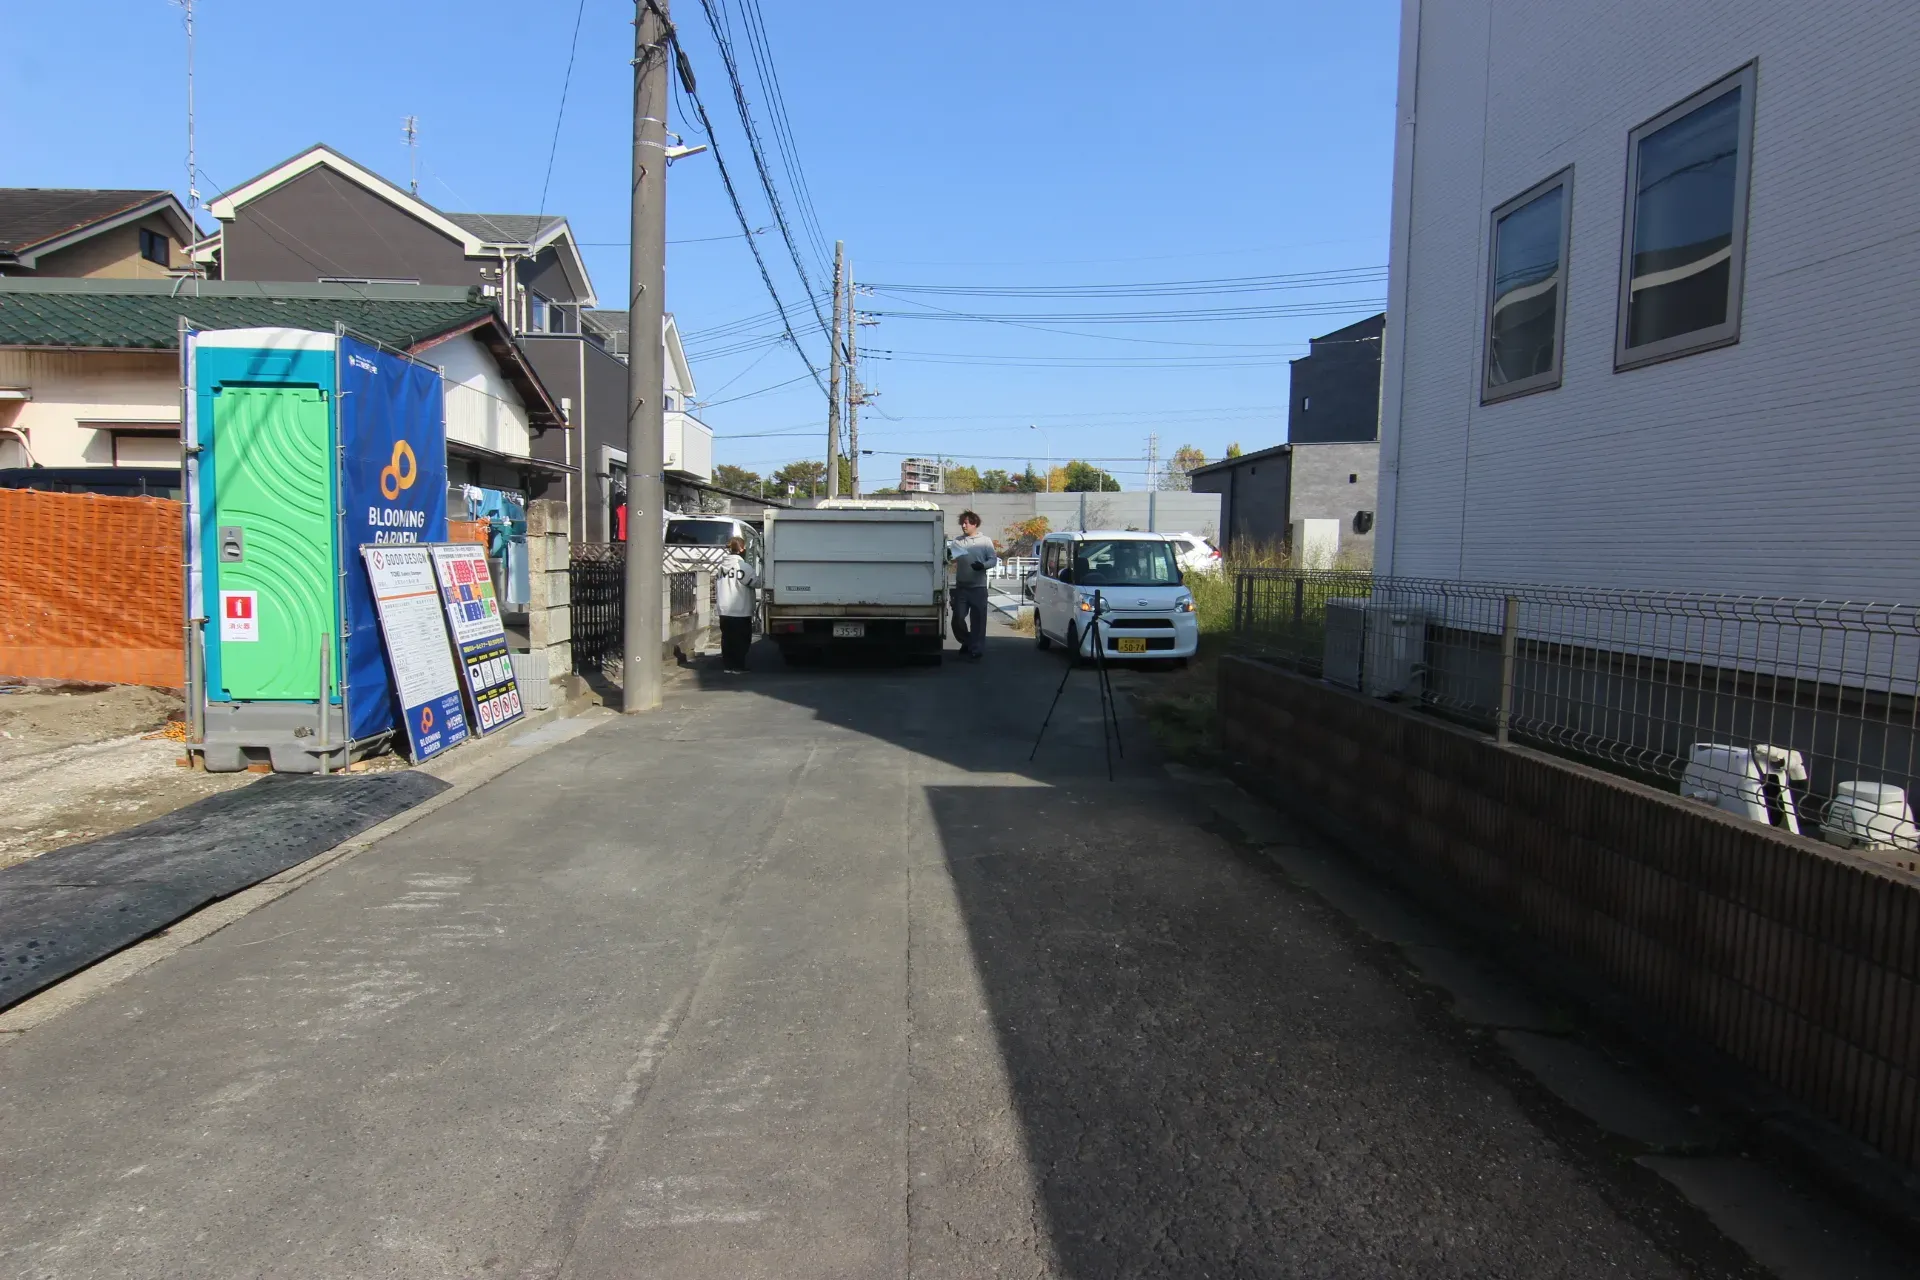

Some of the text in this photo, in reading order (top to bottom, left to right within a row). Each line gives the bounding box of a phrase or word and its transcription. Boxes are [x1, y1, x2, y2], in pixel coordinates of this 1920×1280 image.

[368, 506, 425, 528] BLOOMING
[375, 530, 418, 543] GARDEN
[385, 553, 404, 566] GOOD
[404, 552, 428, 565] DESIGN
[419, 731, 442, 748] BLOOMING
[423, 740, 441, 755] GARDEN
